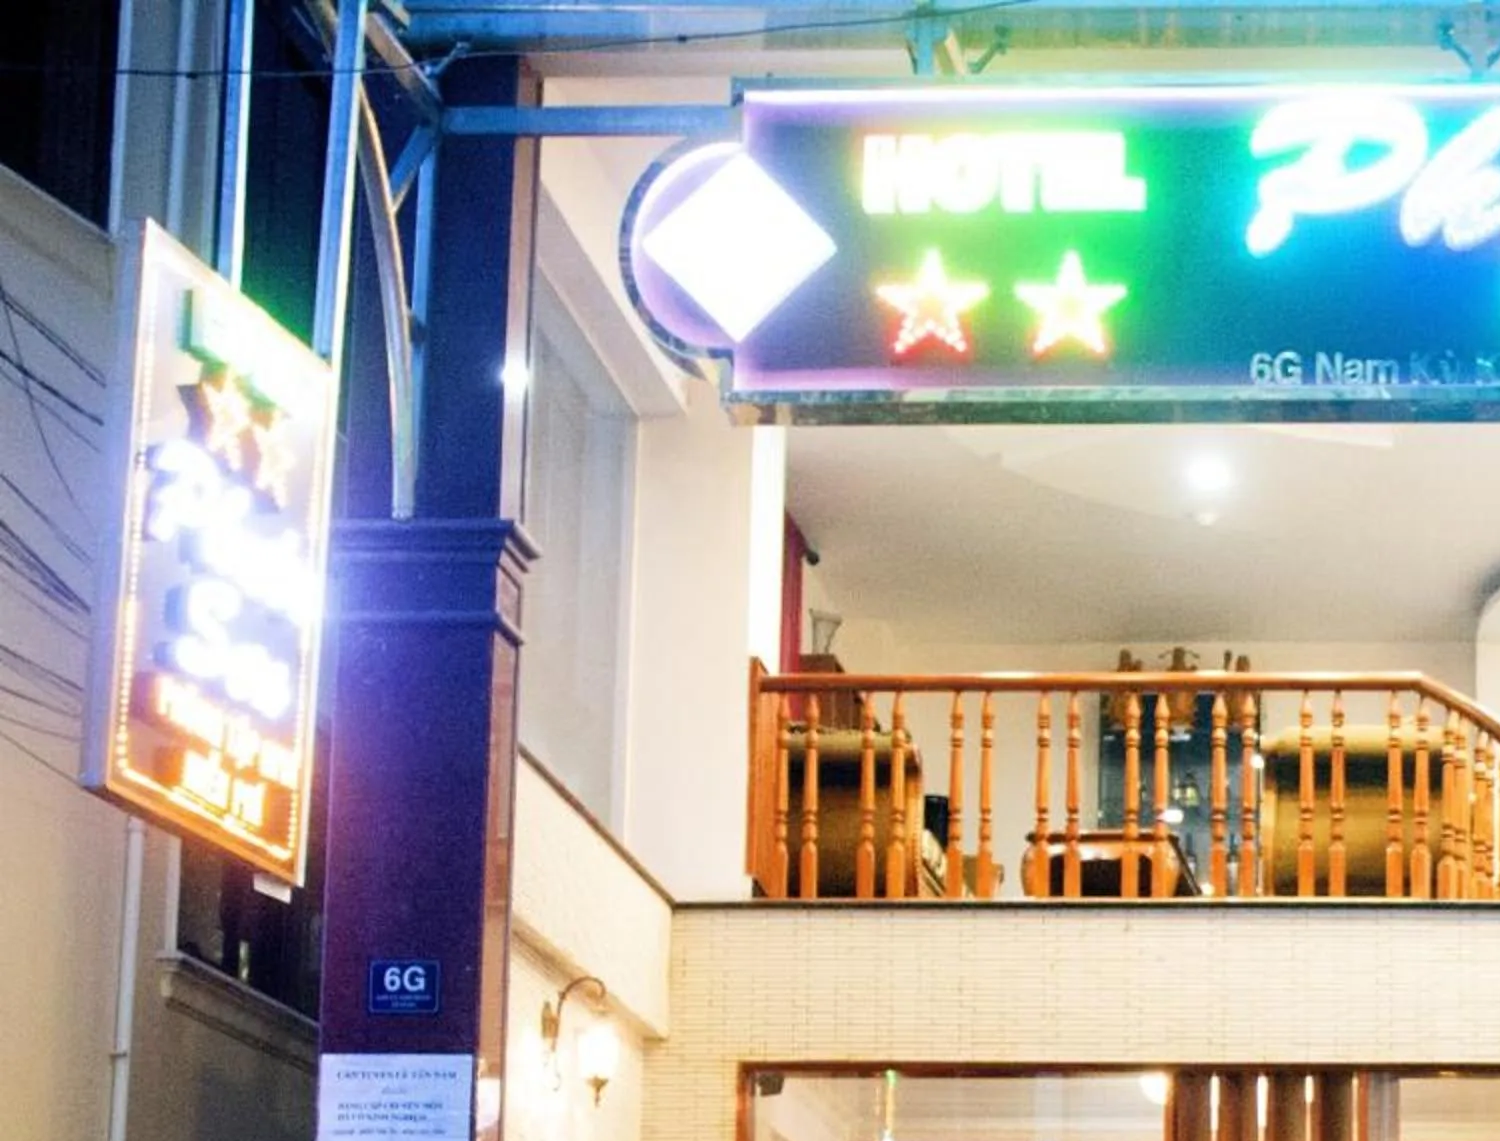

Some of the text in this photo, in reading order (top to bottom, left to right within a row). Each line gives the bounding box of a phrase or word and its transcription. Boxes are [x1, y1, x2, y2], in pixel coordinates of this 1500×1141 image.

[862, 133, 1148, 214] HOTEL
[1250, 350, 1302, 385] 6G
[1314, 351, 1400, 385] Nam
[384, 966, 426, 992] 6G
